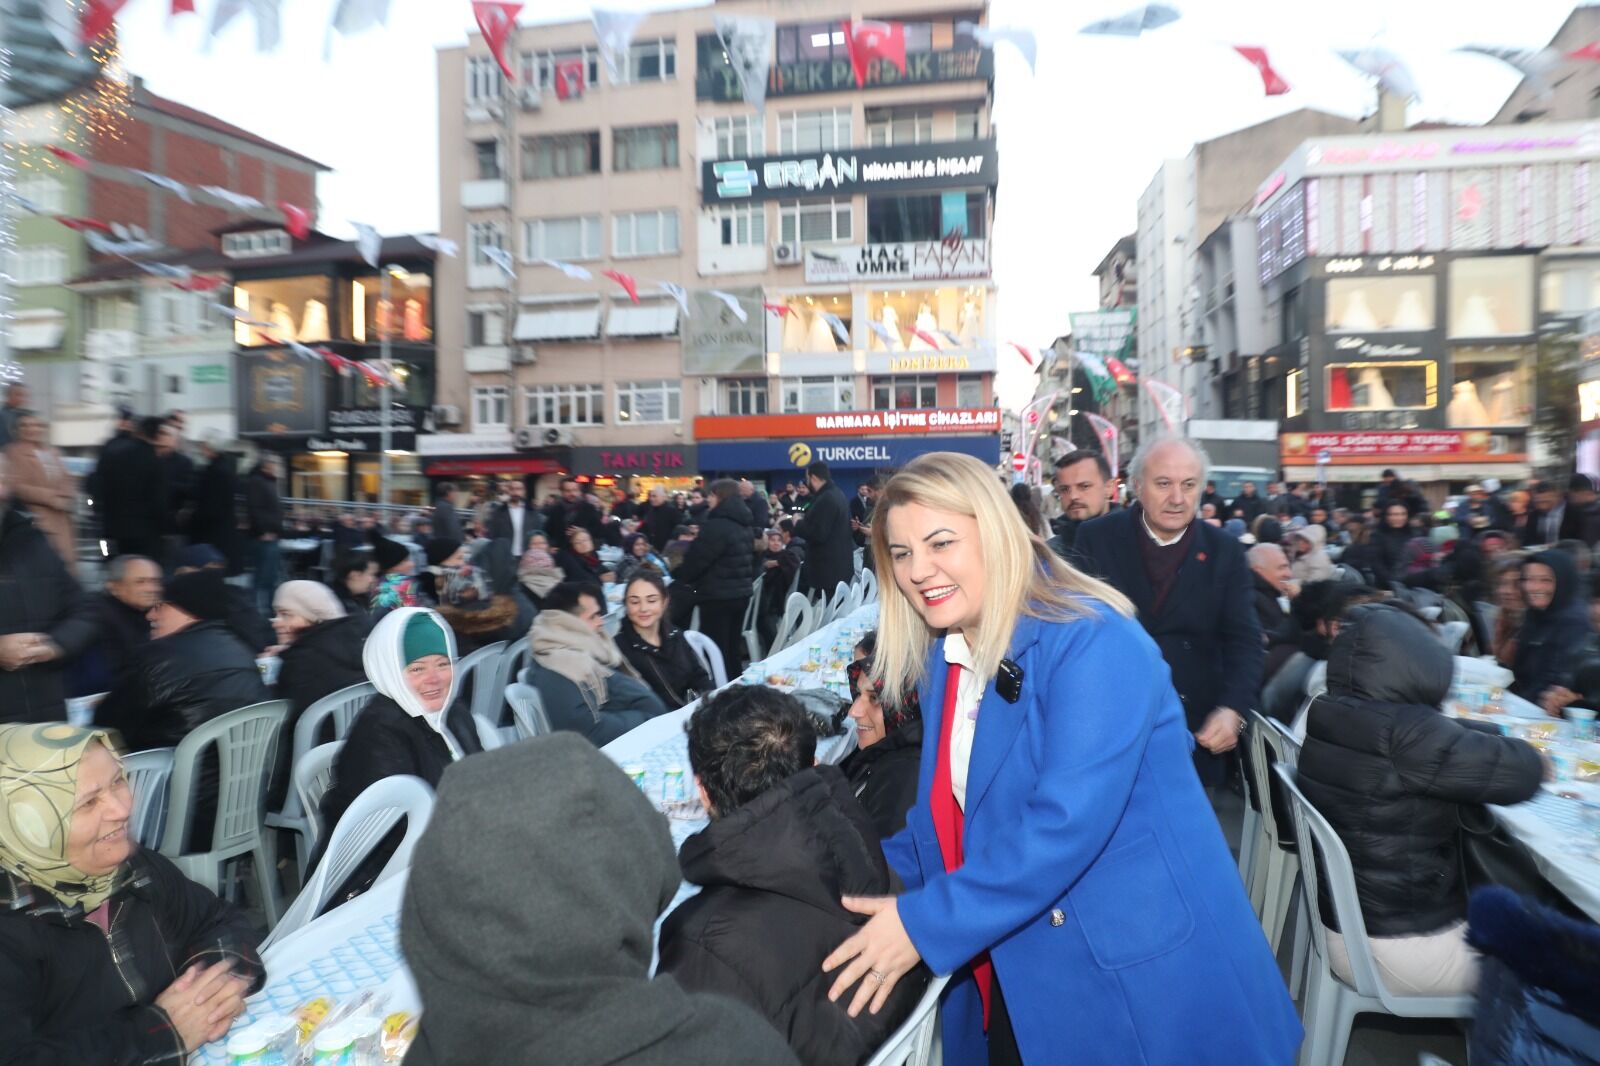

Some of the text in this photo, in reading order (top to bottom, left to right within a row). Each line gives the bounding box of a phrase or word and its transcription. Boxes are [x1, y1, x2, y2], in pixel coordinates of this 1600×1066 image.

[815, 415, 881, 430] MARMARA
[883, 411, 927, 430] İŞİTME
[928, 410, 998, 426] CİHAZLARI
[816, 446, 891, 462] TURKCELL
